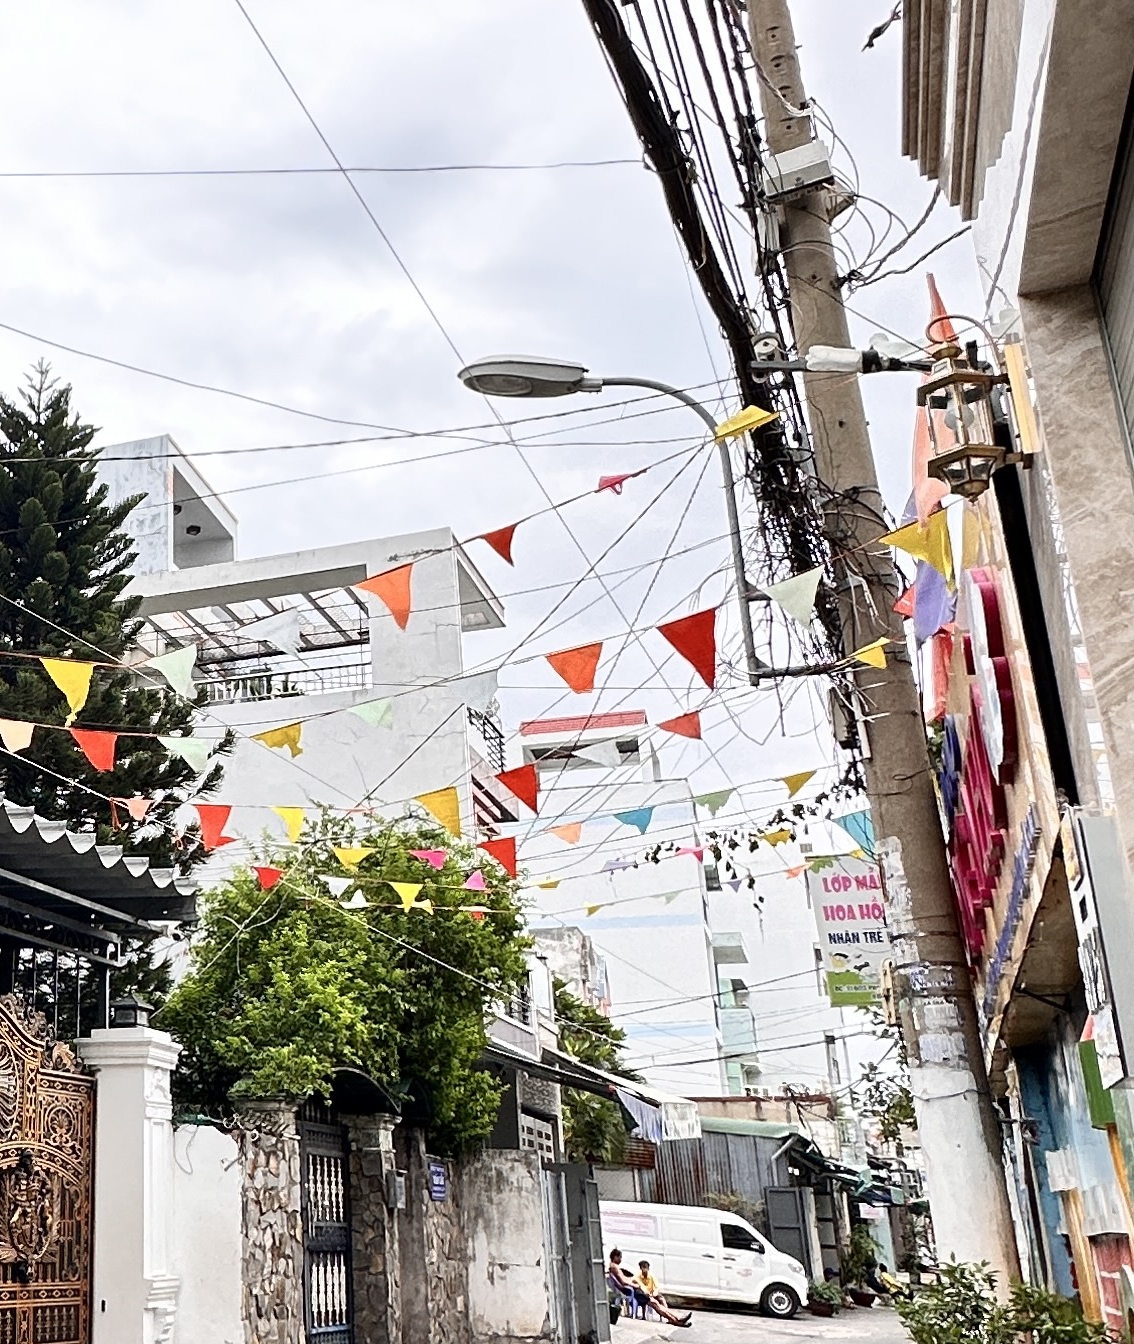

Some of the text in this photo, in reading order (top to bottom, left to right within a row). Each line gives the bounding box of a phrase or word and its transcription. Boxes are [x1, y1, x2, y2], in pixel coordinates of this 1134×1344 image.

[822, 872, 852, 893] LỚP
[822, 895, 884, 922] HOA HỒ
[828, 929, 860, 946] NHẬN
